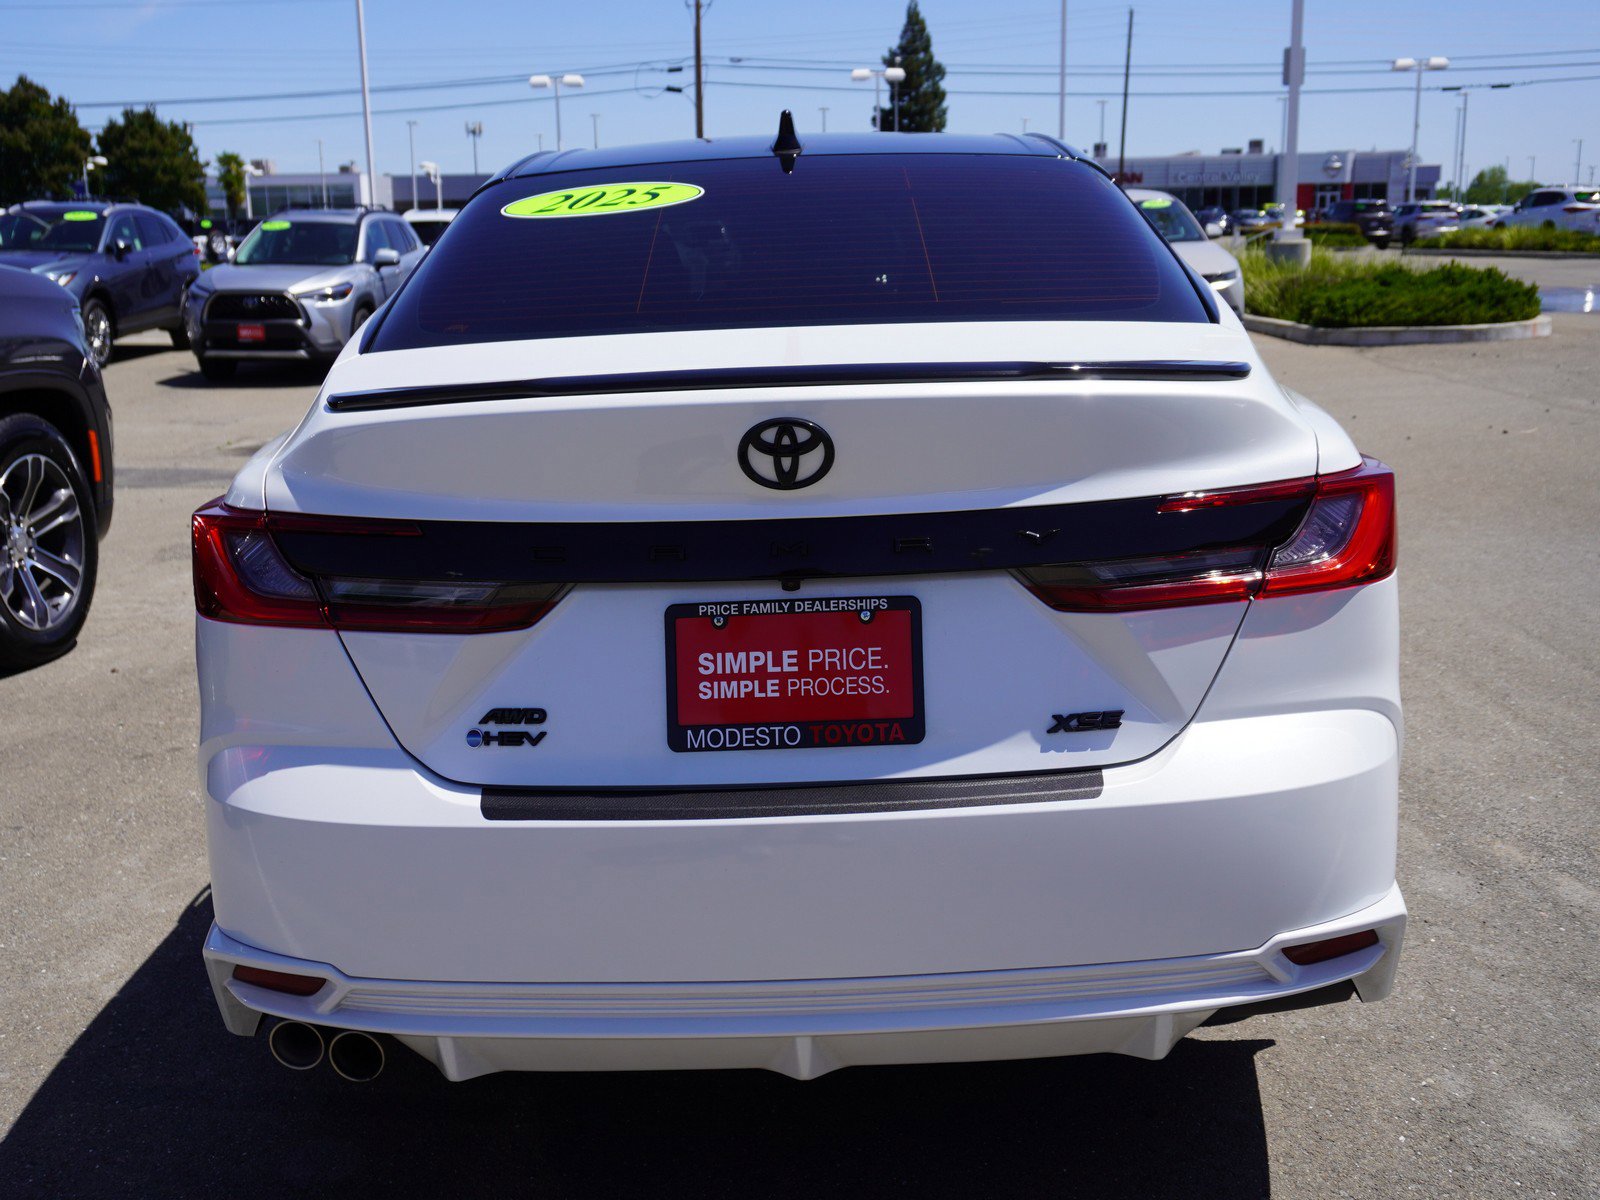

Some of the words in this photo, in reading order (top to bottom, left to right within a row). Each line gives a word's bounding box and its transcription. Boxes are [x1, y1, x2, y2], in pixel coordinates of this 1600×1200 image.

[531, 186, 672, 214] 2025
[699, 604, 738, 615] PRICE
[743, 602, 789, 613] FAMILY
[794, 598, 888, 611] DEALERSHIPS
[698, 650, 798, 675] SIMPLE
[808, 647, 889, 671] PRICE.
[698, 679, 780, 700] SIMPLE
[787, 676, 890, 696] PROCESS.
[478, 707, 547, 725] AWD
[1046, 709, 1125, 734] XSE
[483, 731, 547, 747] HEV
[686, 725, 801, 749] MODESTO
[809, 723, 905, 744] TOYOTA
